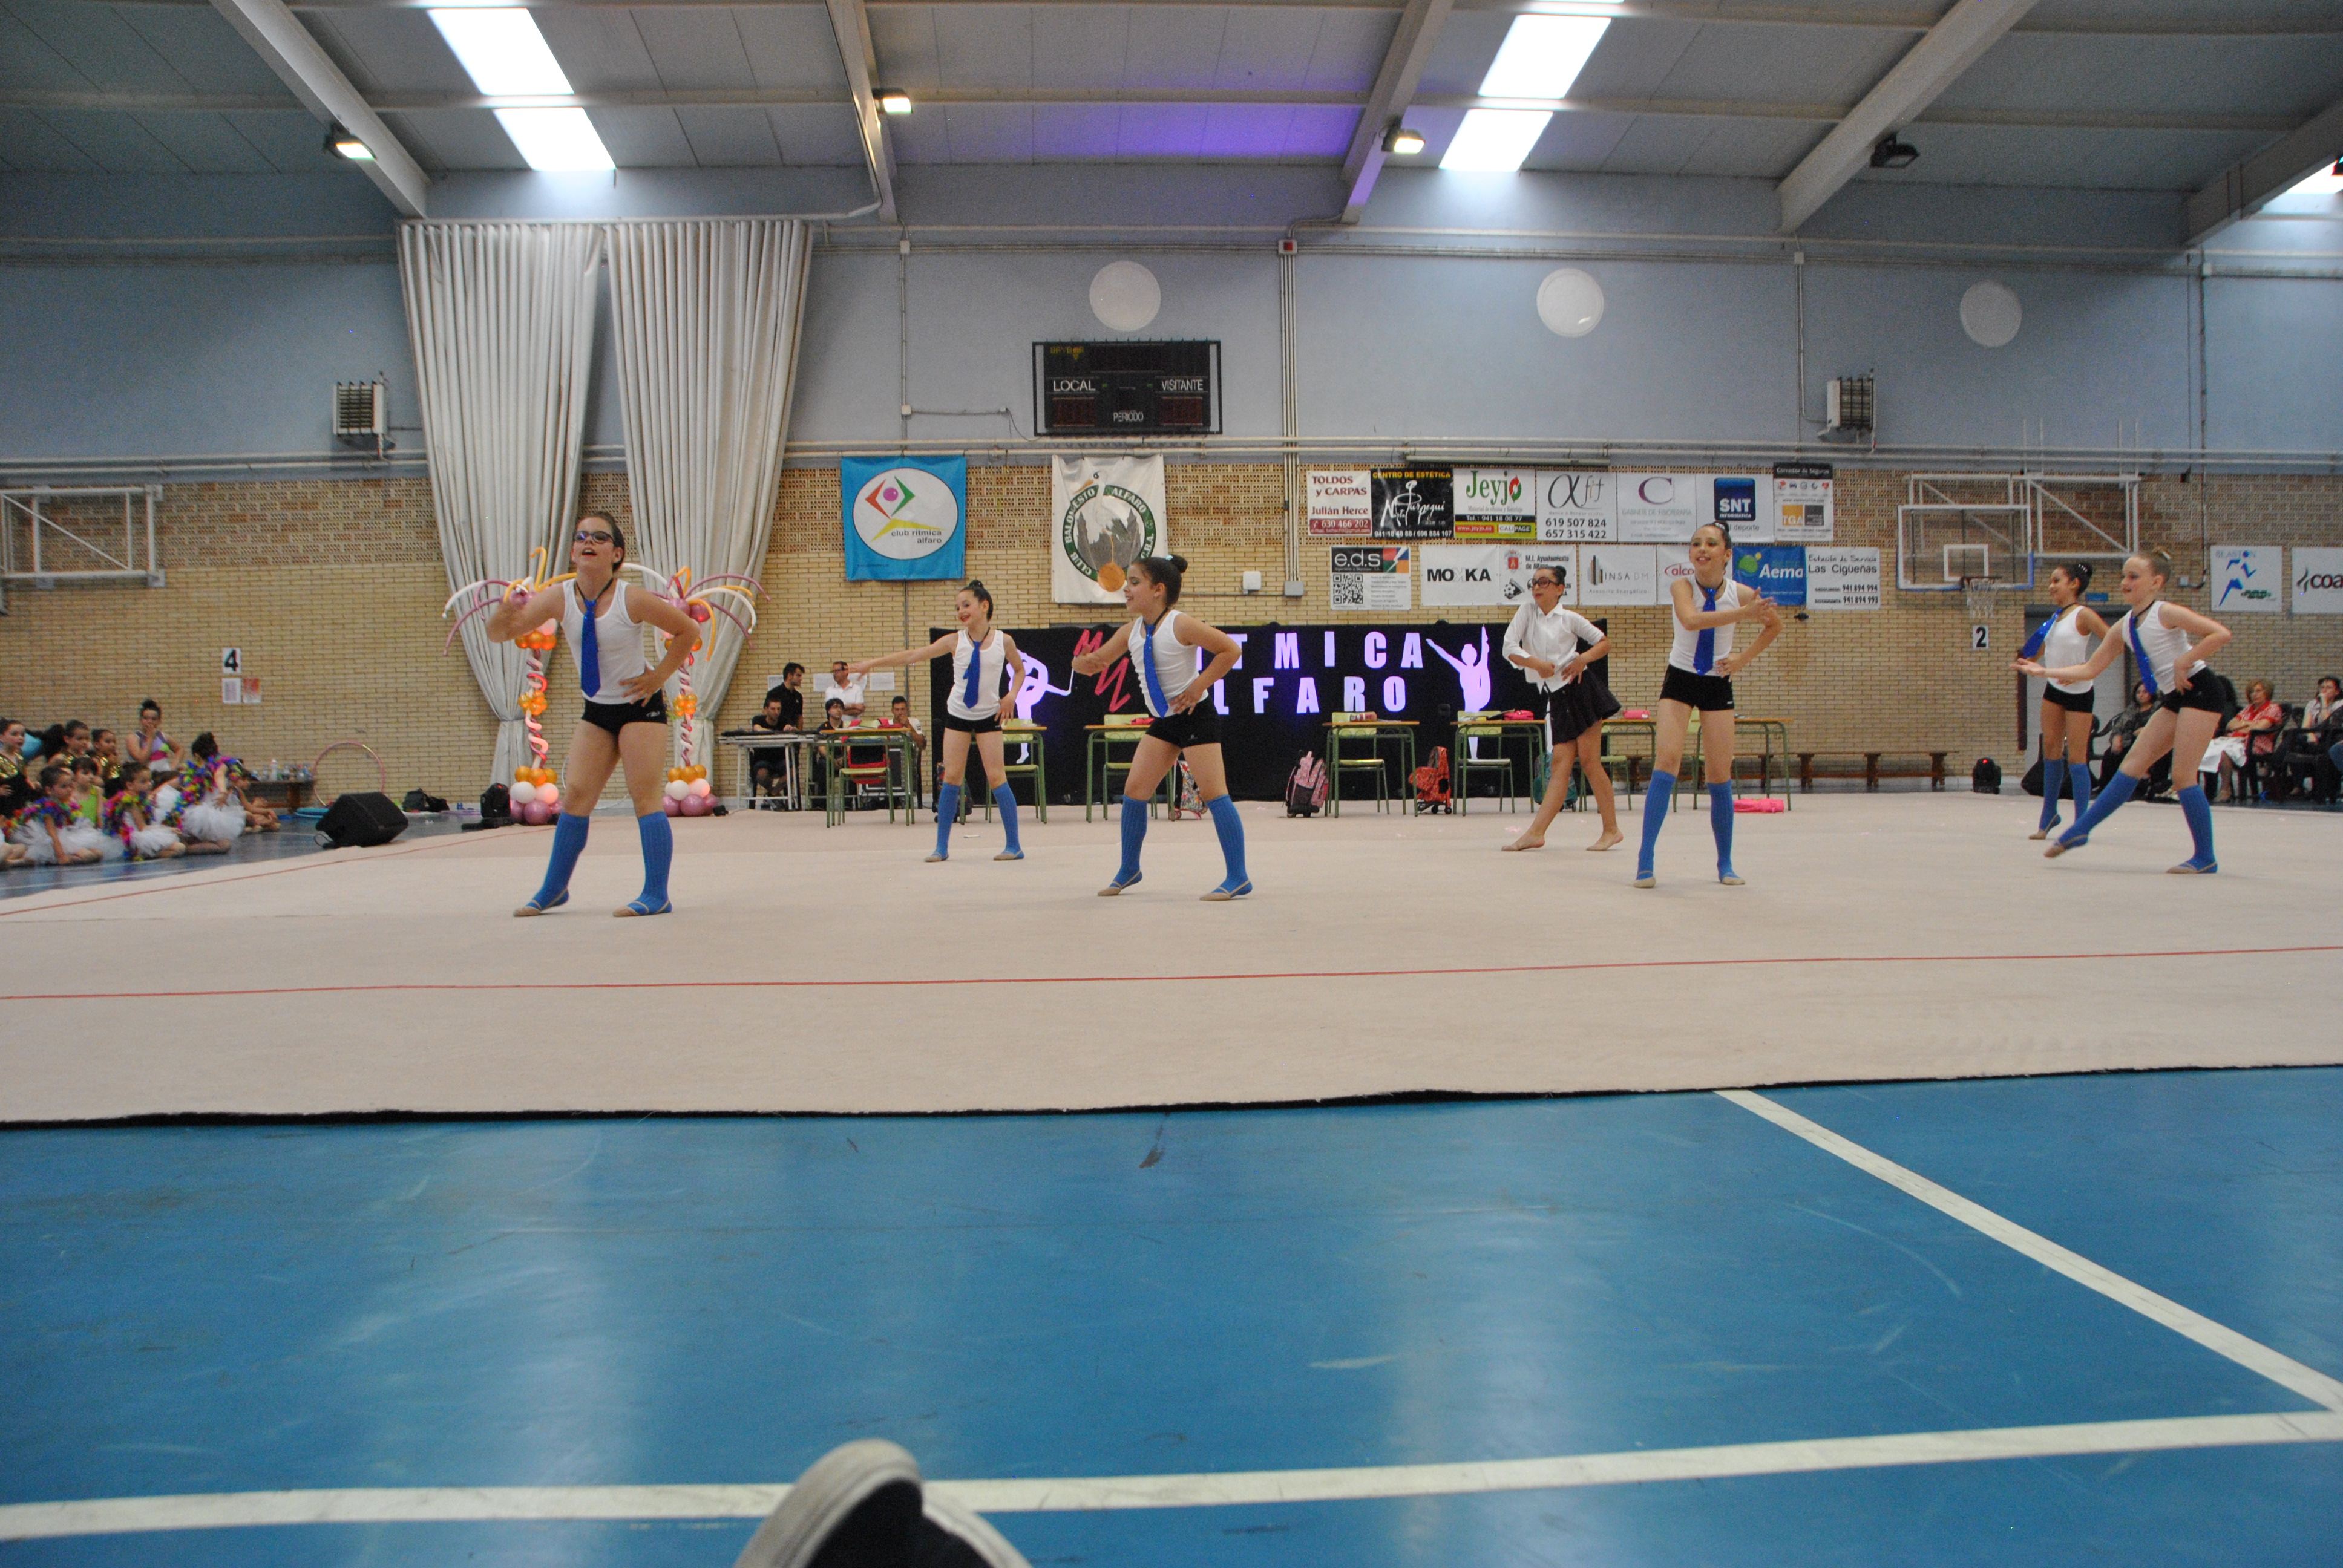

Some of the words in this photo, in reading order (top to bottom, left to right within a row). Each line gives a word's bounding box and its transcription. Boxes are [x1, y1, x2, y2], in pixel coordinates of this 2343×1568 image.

[1053, 379, 1096, 391] LOCAL
[1162, 379, 1203, 391] VISITANTE
[1113, 411, 1144, 422] PERIODO
[1312, 475, 1353, 484] TOLDOS
[1316, 489, 1322, 497] y
[1325, 487, 1367, 495] CARPAS
[1466, 470, 1522, 505] Jeyjo
[1312, 506, 1339, 515] Julián
[1342, 506, 1368, 515] Herce
[1720, 498, 1751, 512] SNT
[1546, 518, 1564, 527] 619
[1567, 518, 1585, 527] 507
[1588, 518, 1606, 527] 824
[1783, 515, 1803, 525] TGA
[1070, 552, 1092, 575] CLUB
[1112, 488, 1147, 513] ALFARO
[1546, 529, 1564, 538] 657
[1567, 530, 1585, 538] 315
[1588, 530, 1606, 538] 422
[1808, 564, 1826, 573] Las
[1976, 626, 1987, 647] 2
[224, 649, 238, 671] 4
[1214, 676, 1406, 715] LFARO
